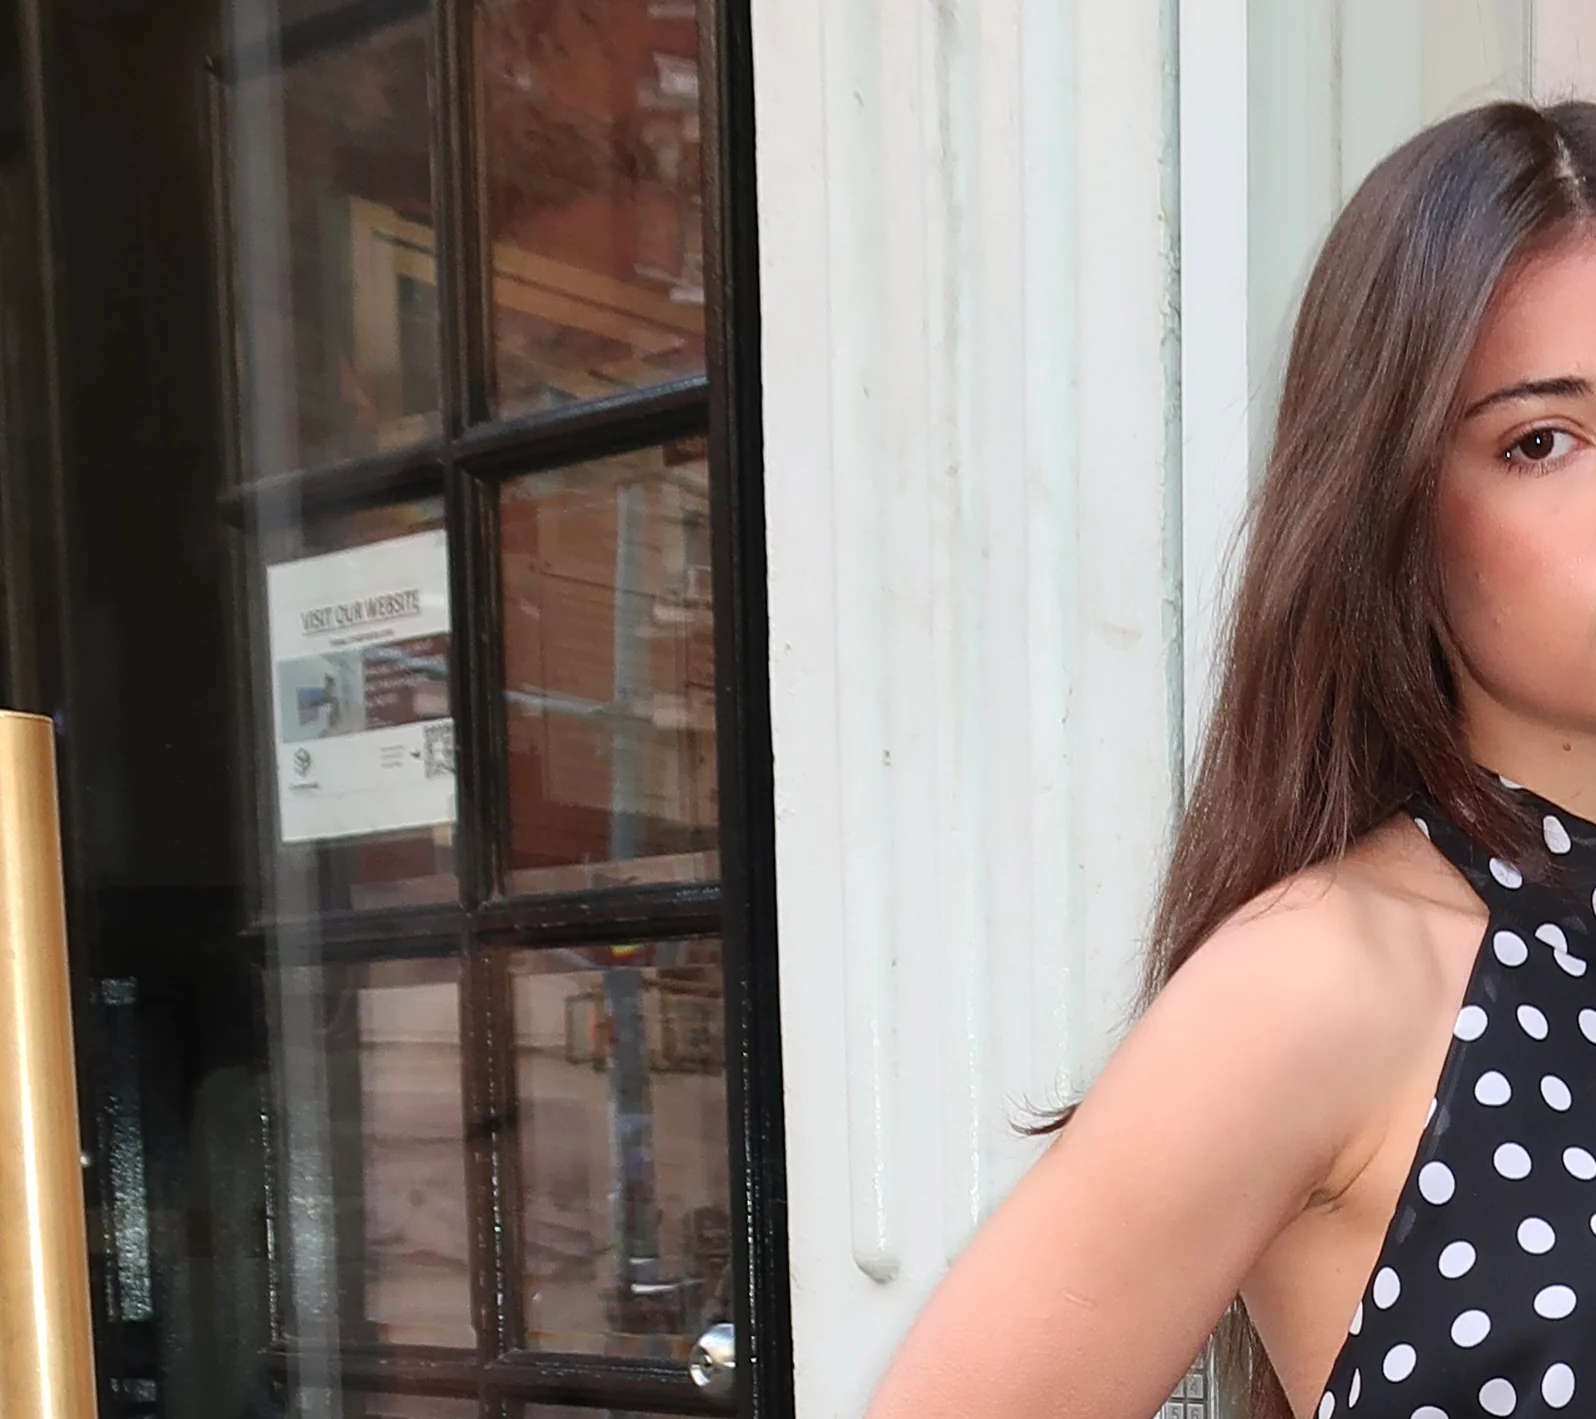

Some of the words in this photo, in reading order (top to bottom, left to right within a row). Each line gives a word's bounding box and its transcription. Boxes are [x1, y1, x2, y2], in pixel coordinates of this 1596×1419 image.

[300, 606, 332, 630] VISIT
[335, 600, 362, 625] OUR
[364, 589, 420, 619] WEBSITE
